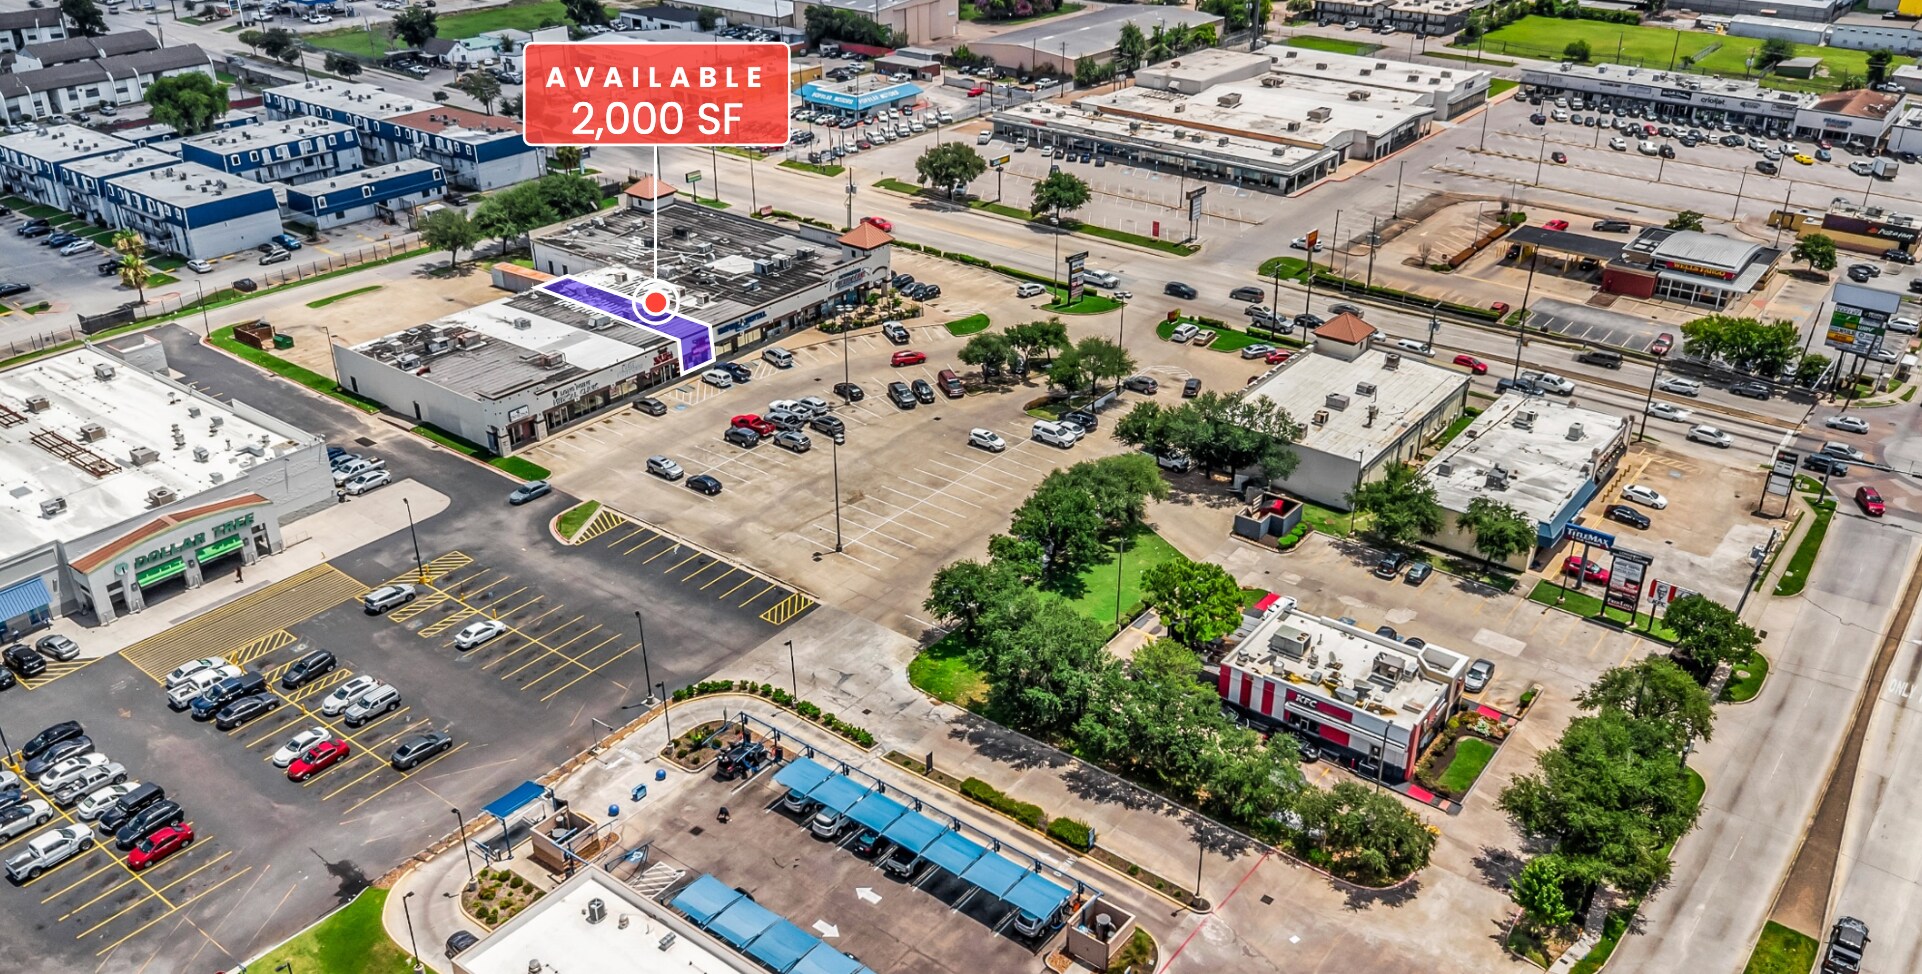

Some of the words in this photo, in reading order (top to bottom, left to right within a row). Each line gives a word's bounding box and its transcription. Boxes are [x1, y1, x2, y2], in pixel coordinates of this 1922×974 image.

[1673, 261, 1699, 272] WELLS
[1700, 267, 1726, 277] FARGO
[134, 532, 206, 569] DOLLAR
[212, 512, 254, 537] TREE
[1889, 679, 1918, 698] ONLY
[1296, 694, 1318, 708] KFC
